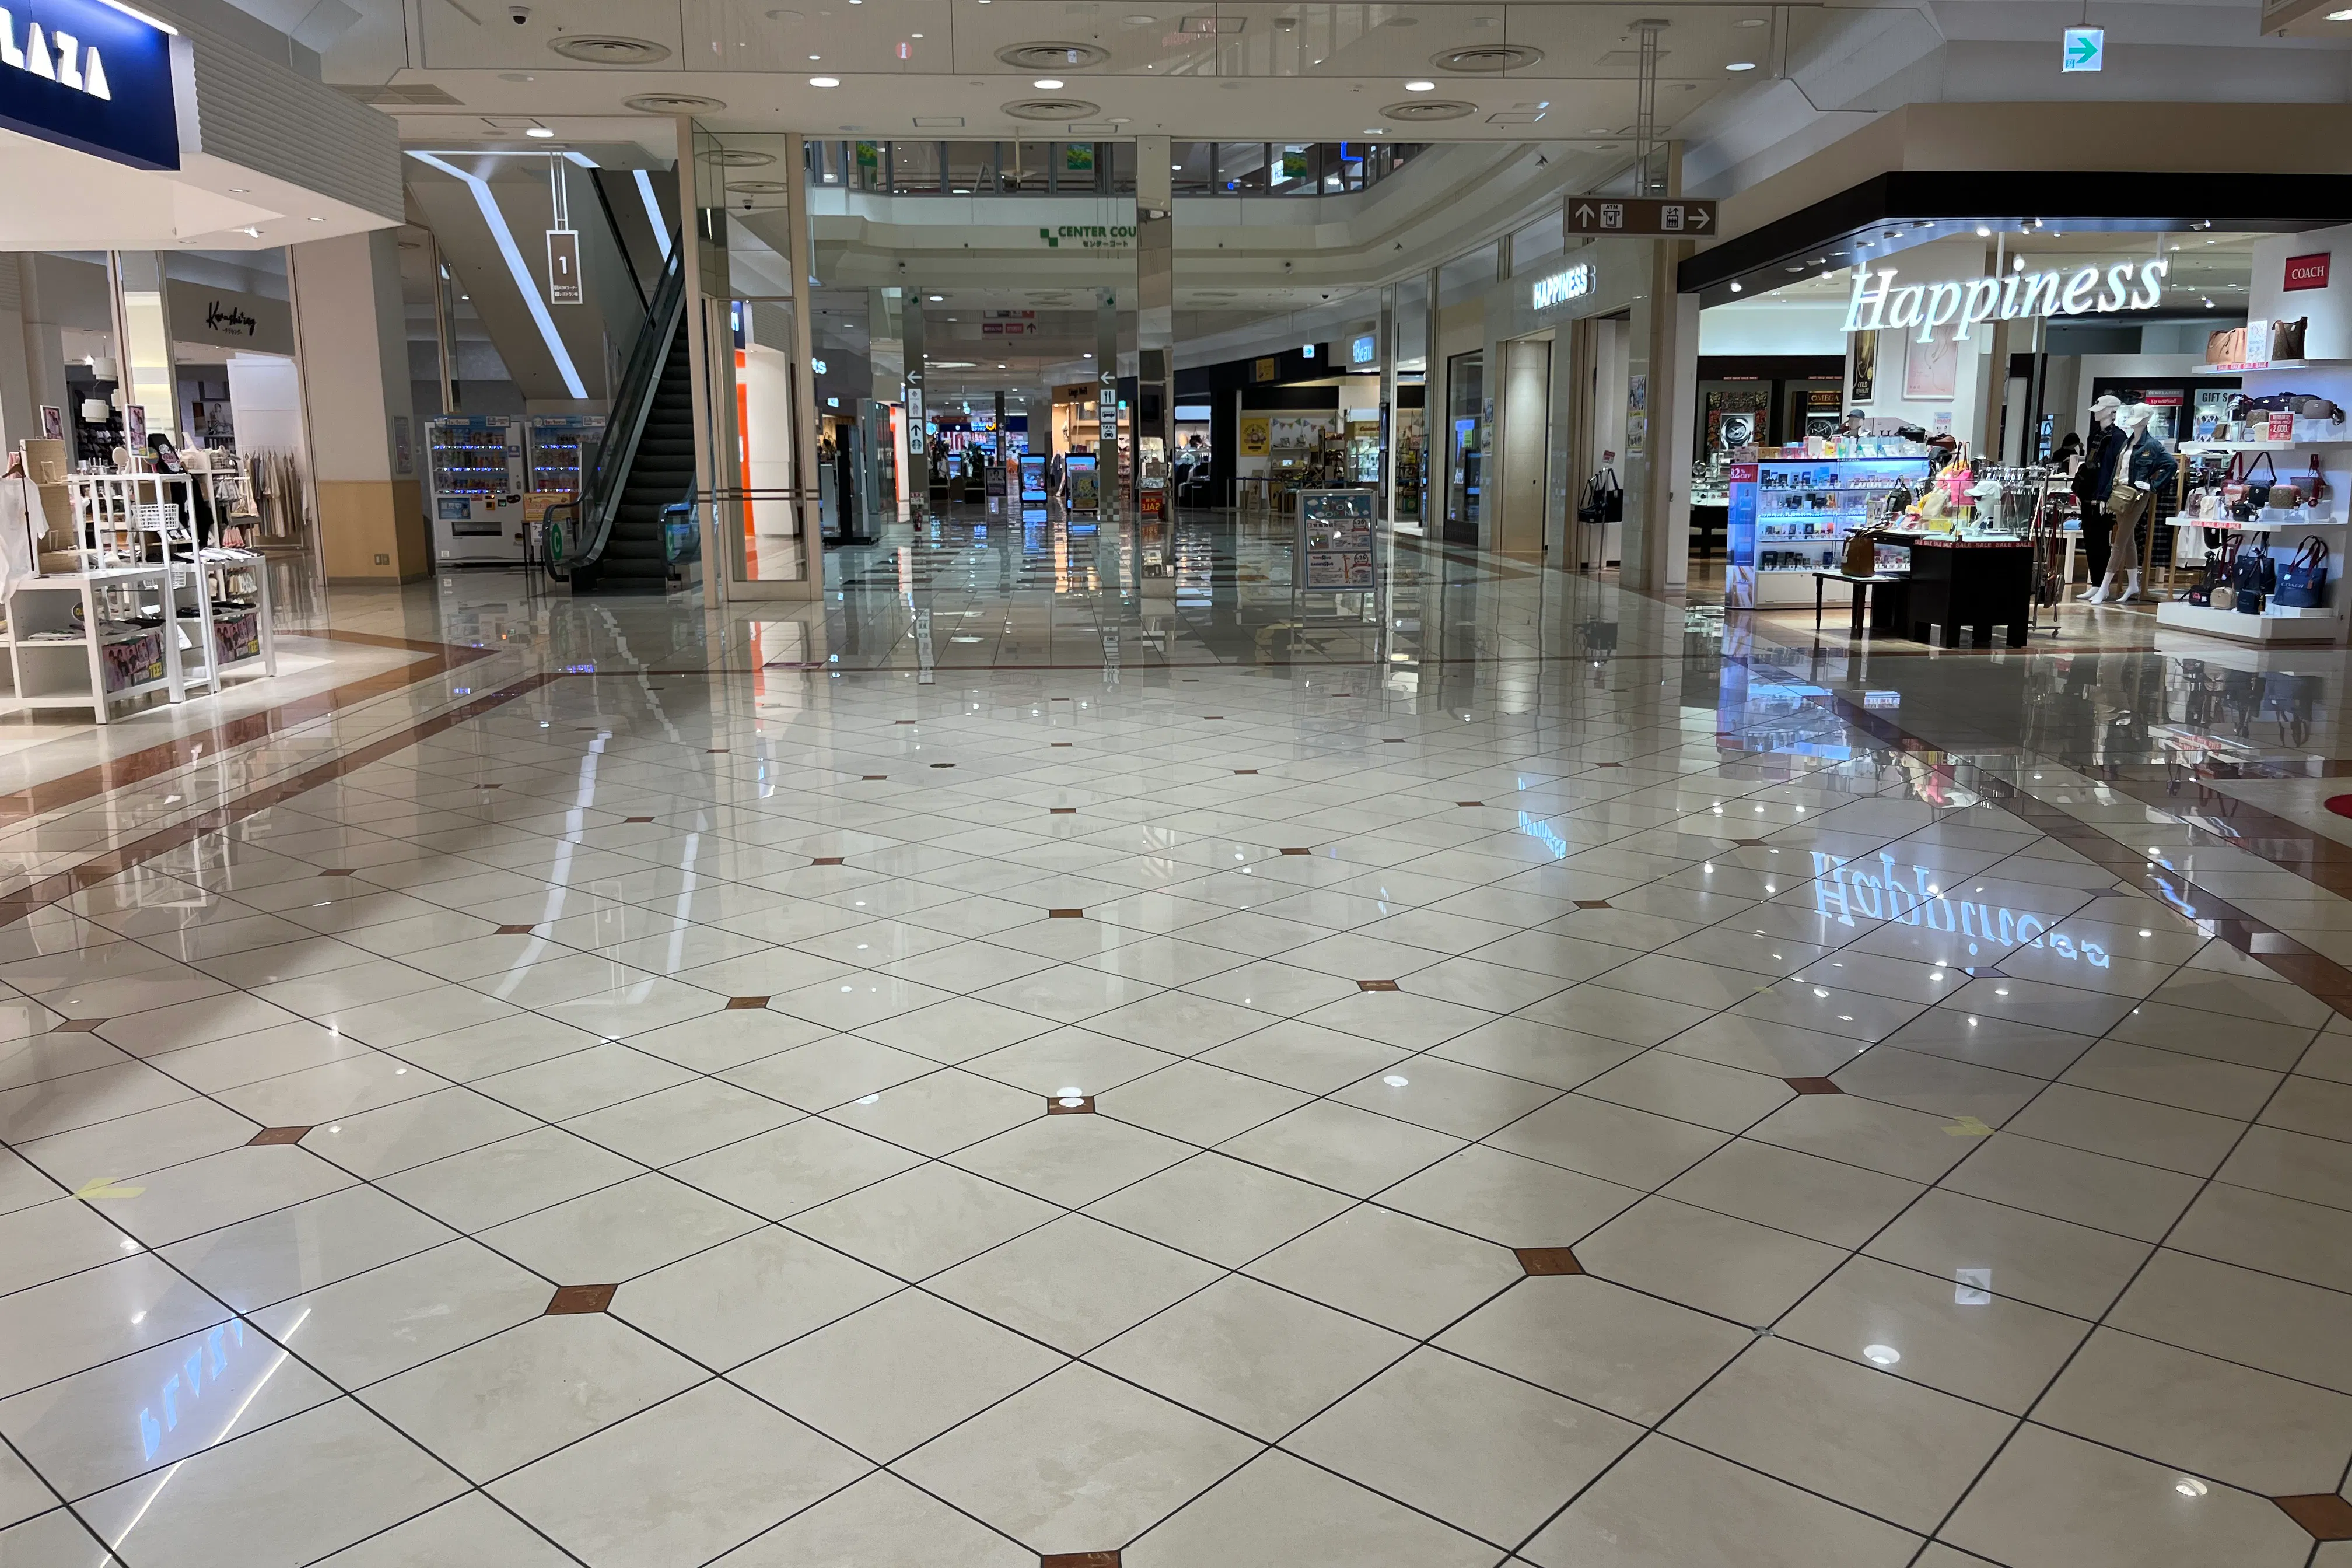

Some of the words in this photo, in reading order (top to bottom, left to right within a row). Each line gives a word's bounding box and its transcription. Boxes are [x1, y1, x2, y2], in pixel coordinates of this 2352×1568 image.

[1058, 226, 1107, 237] CENTER
[1110, 226, 1137, 237] COU
[559, 256, 568, 274] 1
[2291, 265, 2325, 280] COACH
[1534, 263, 1588, 310] HAPPINESS
[1839, 258, 2169, 344] Happiness
[1811, 394, 1840, 402] OMEGA
[2202, 393, 2220, 402] GIFT
[554, 531, 560, 552] C
